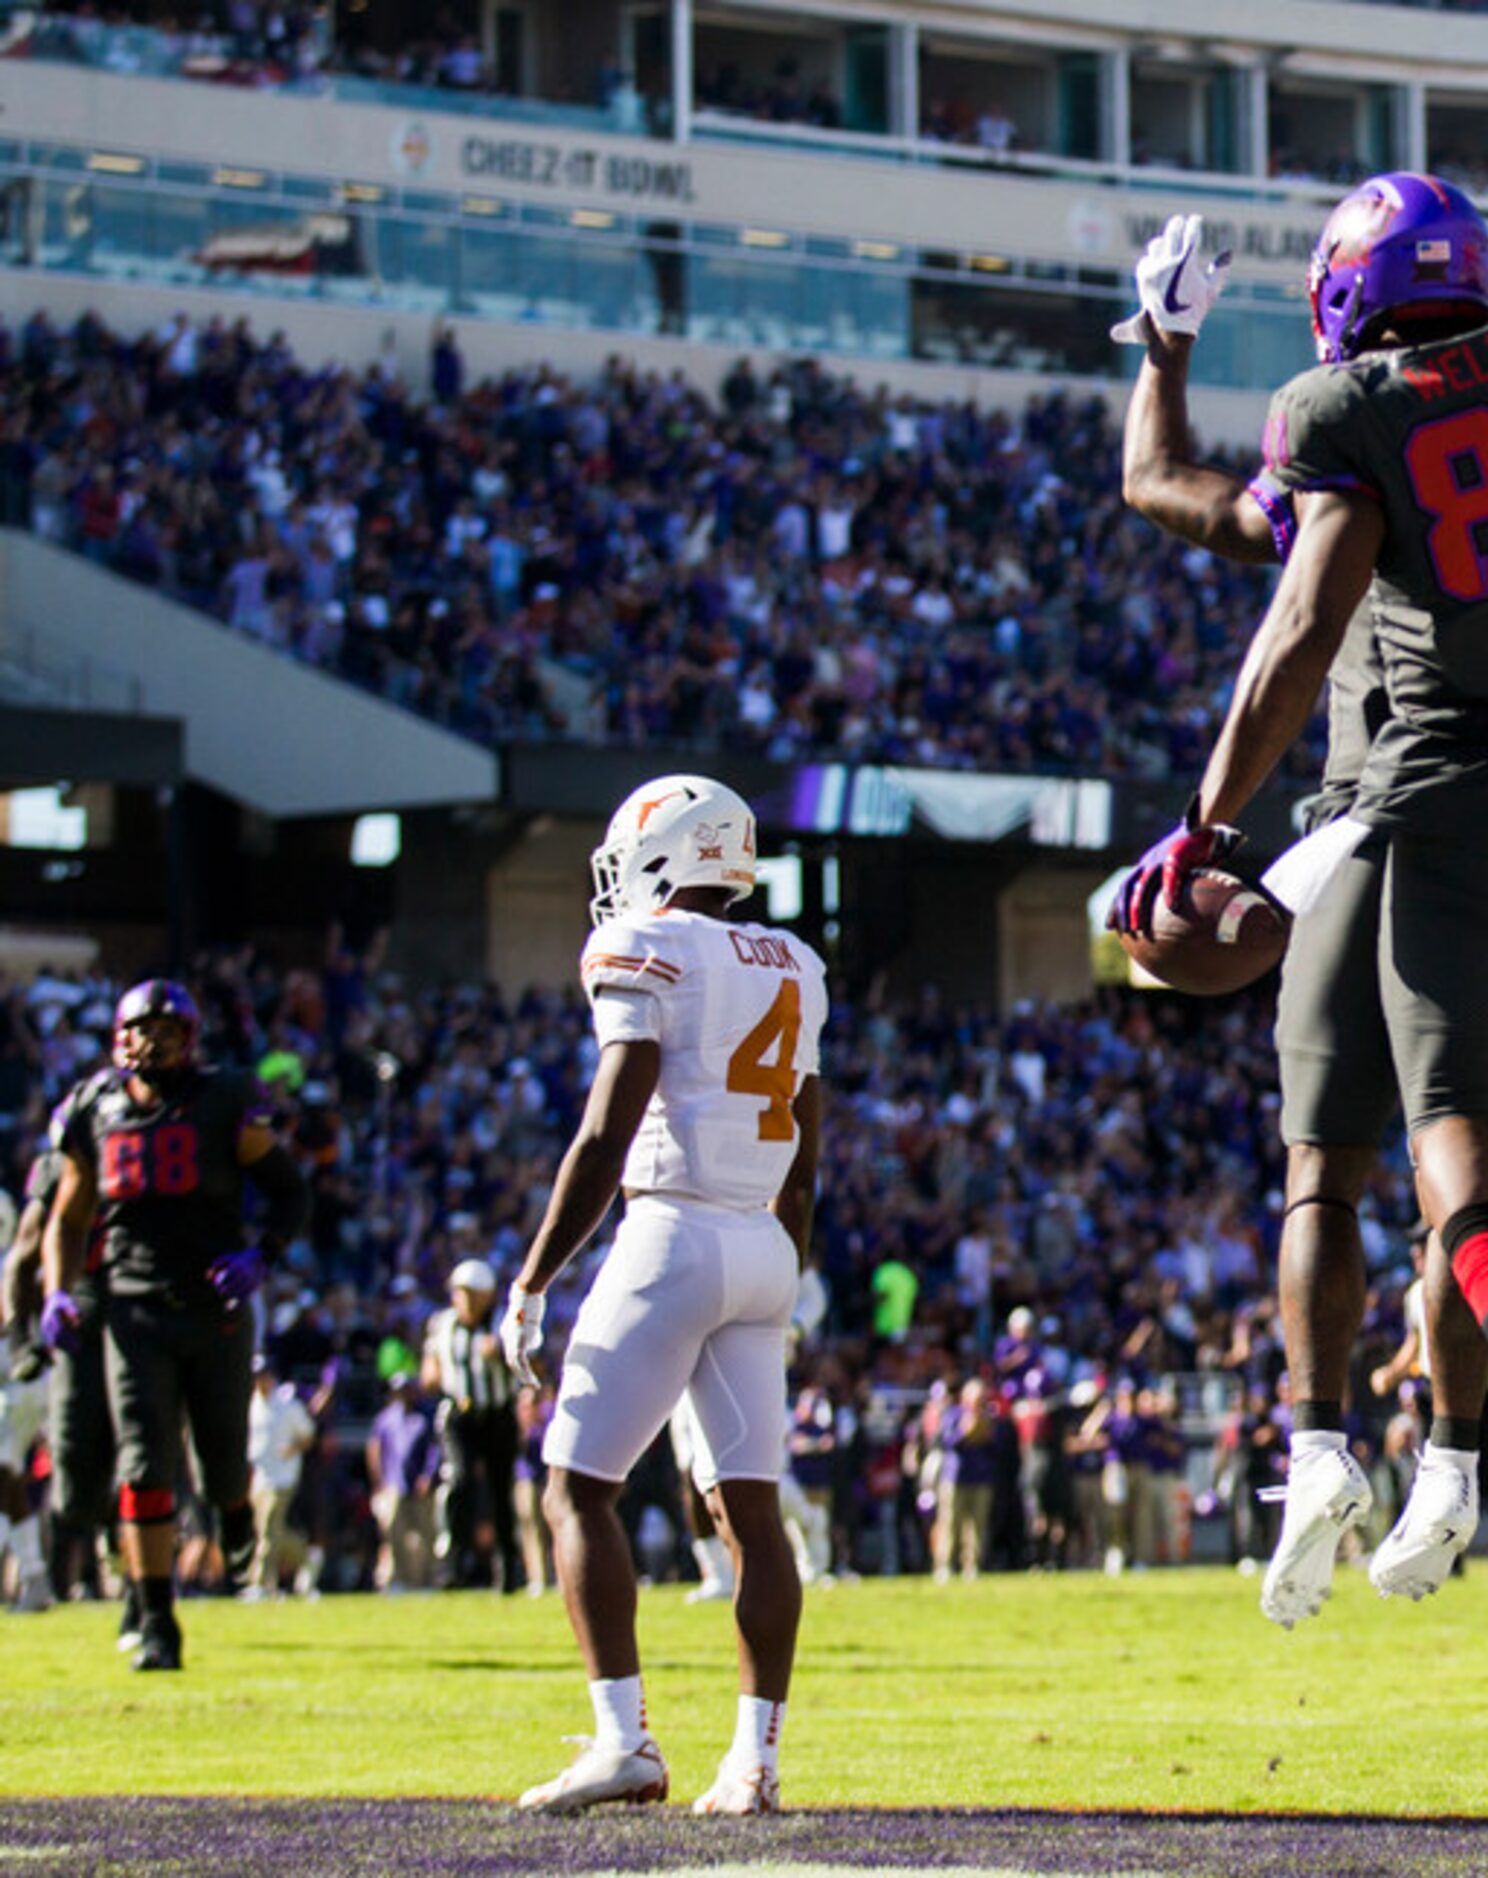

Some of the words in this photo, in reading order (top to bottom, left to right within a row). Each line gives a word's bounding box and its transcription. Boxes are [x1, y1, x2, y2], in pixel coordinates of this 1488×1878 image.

[605, 155, 696, 203] BOWL
[727, 929, 802, 972] COOK
[726, 977, 802, 1141] 4
[99, 1124, 200, 1199] 68
